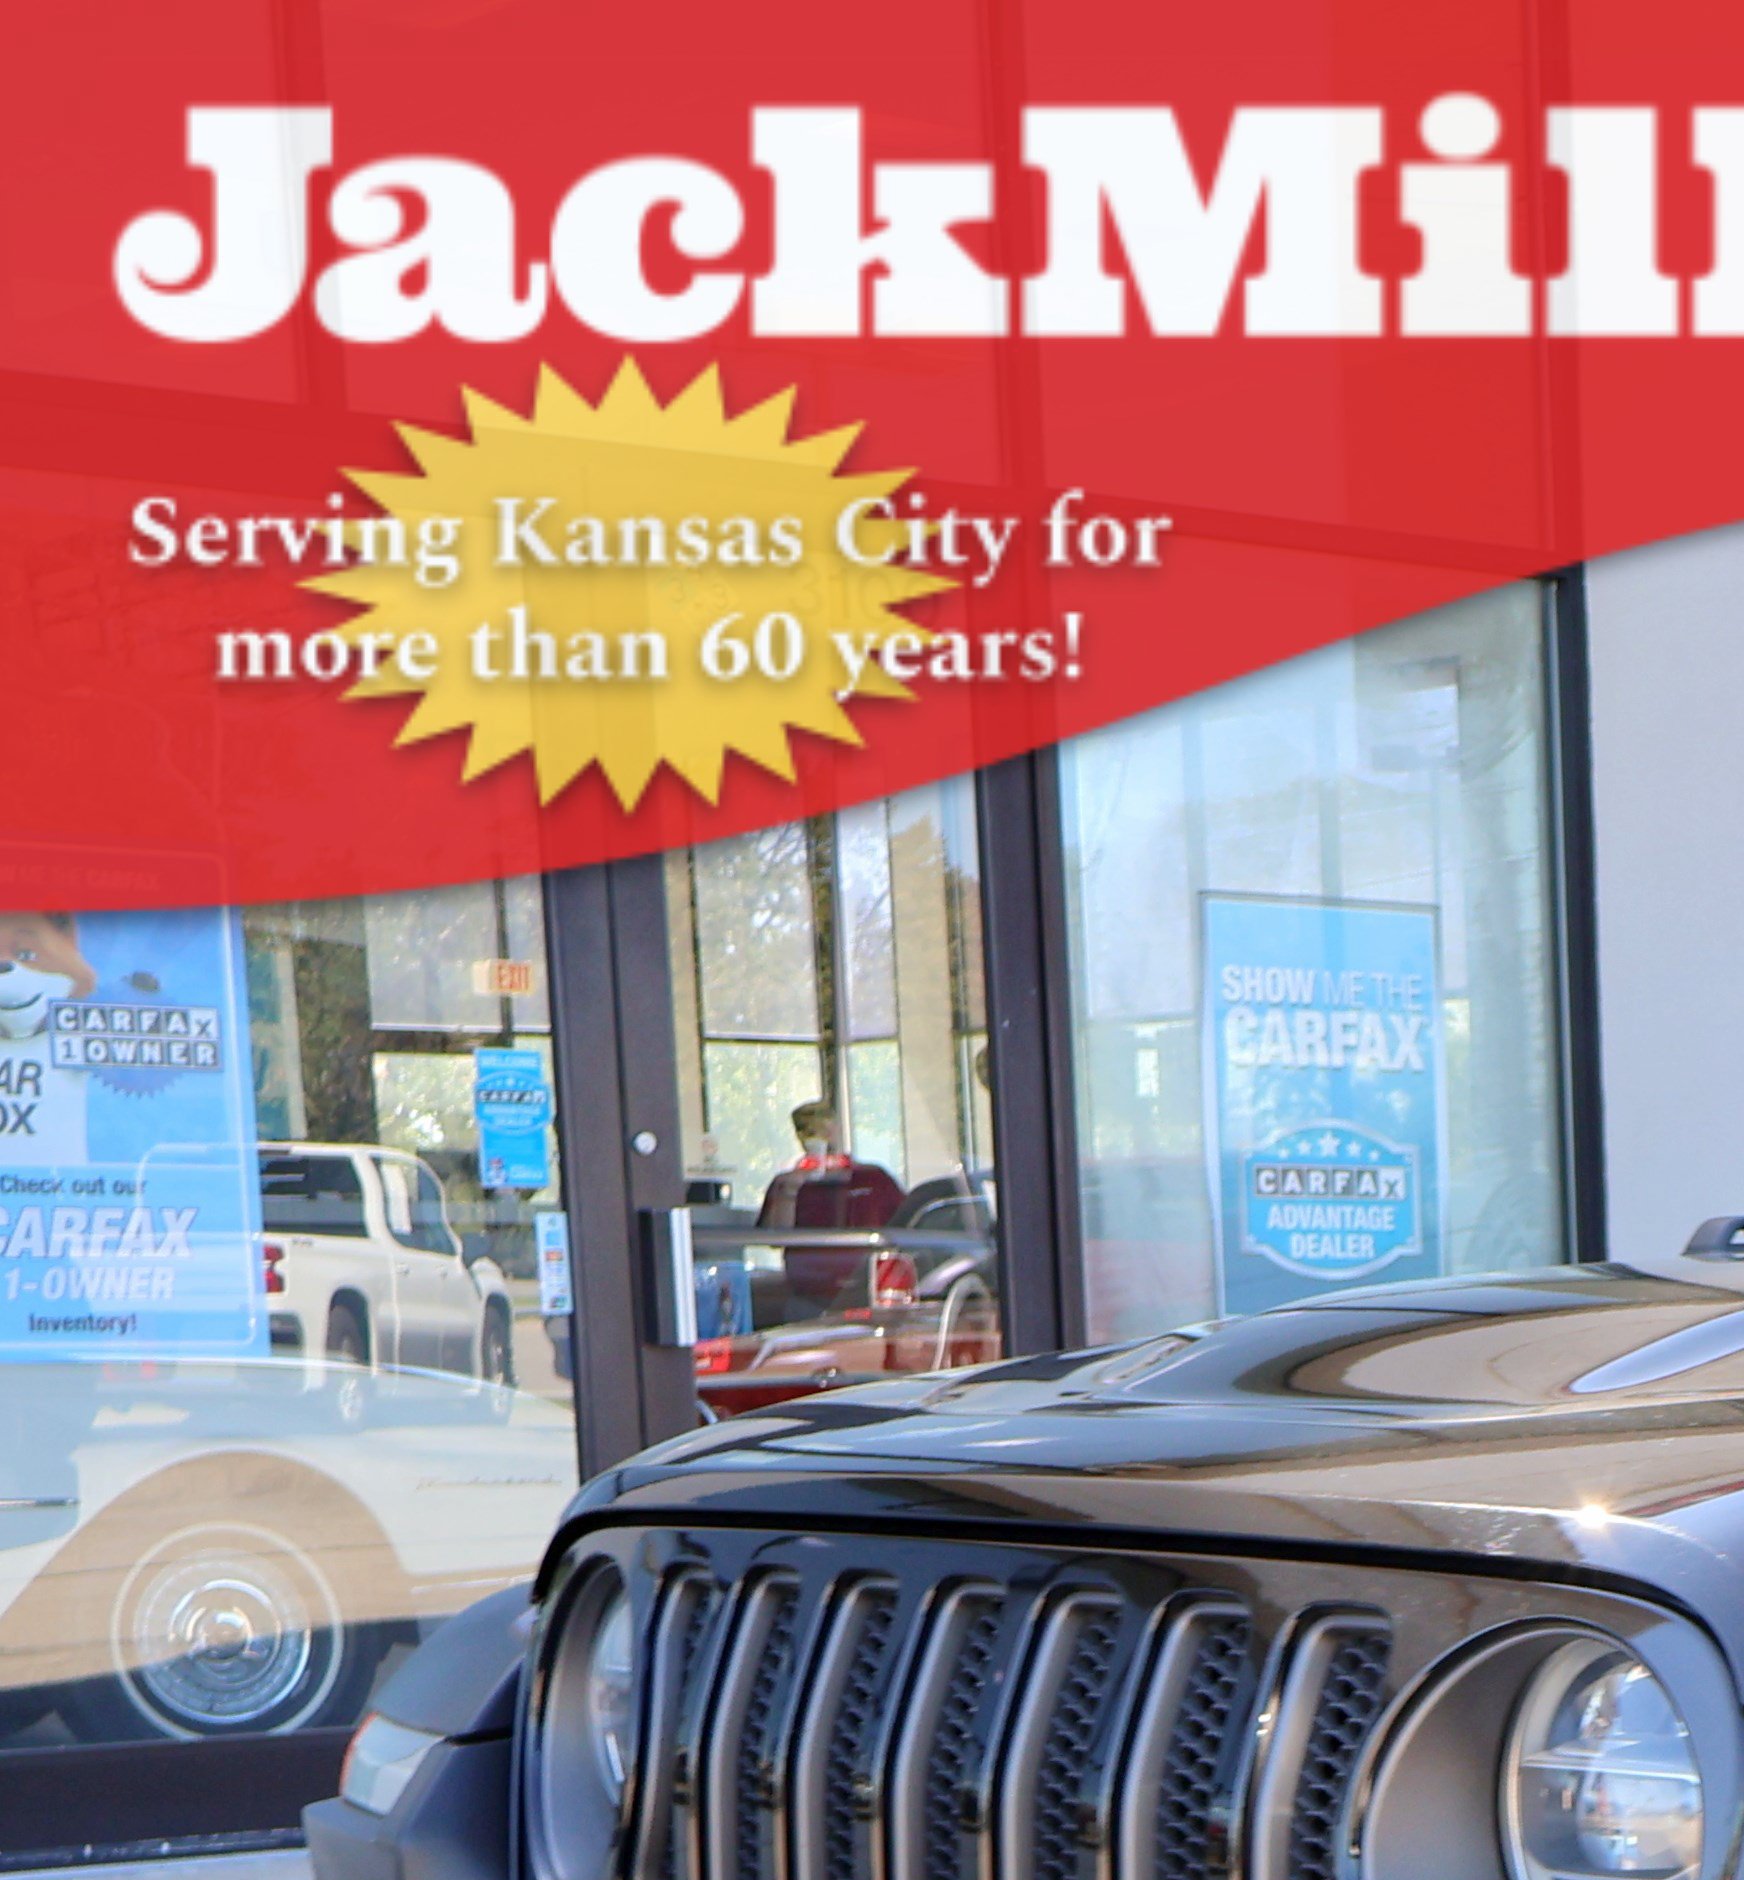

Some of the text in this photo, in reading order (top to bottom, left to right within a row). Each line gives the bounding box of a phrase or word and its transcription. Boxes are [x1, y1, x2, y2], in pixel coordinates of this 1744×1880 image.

[495, 962, 531, 990] EXIT
[1221, 964, 1424, 1011] SHOW ME THE
[54, 1005, 217, 1041] CARFAX
[1224, 1006, 1427, 1073] CARFAX
[0, 1174, 148, 1195] Check out our
[1255, 1165, 1406, 1200] CARFAX
[1266, 1203, 1396, 1233] ADVANTAGE
[1290, 1231, 1376, 1260] DEALER
[4, 1266, 177, 1301] 1-OWNER
[27, 1312, 138, 1336] Inventory!
